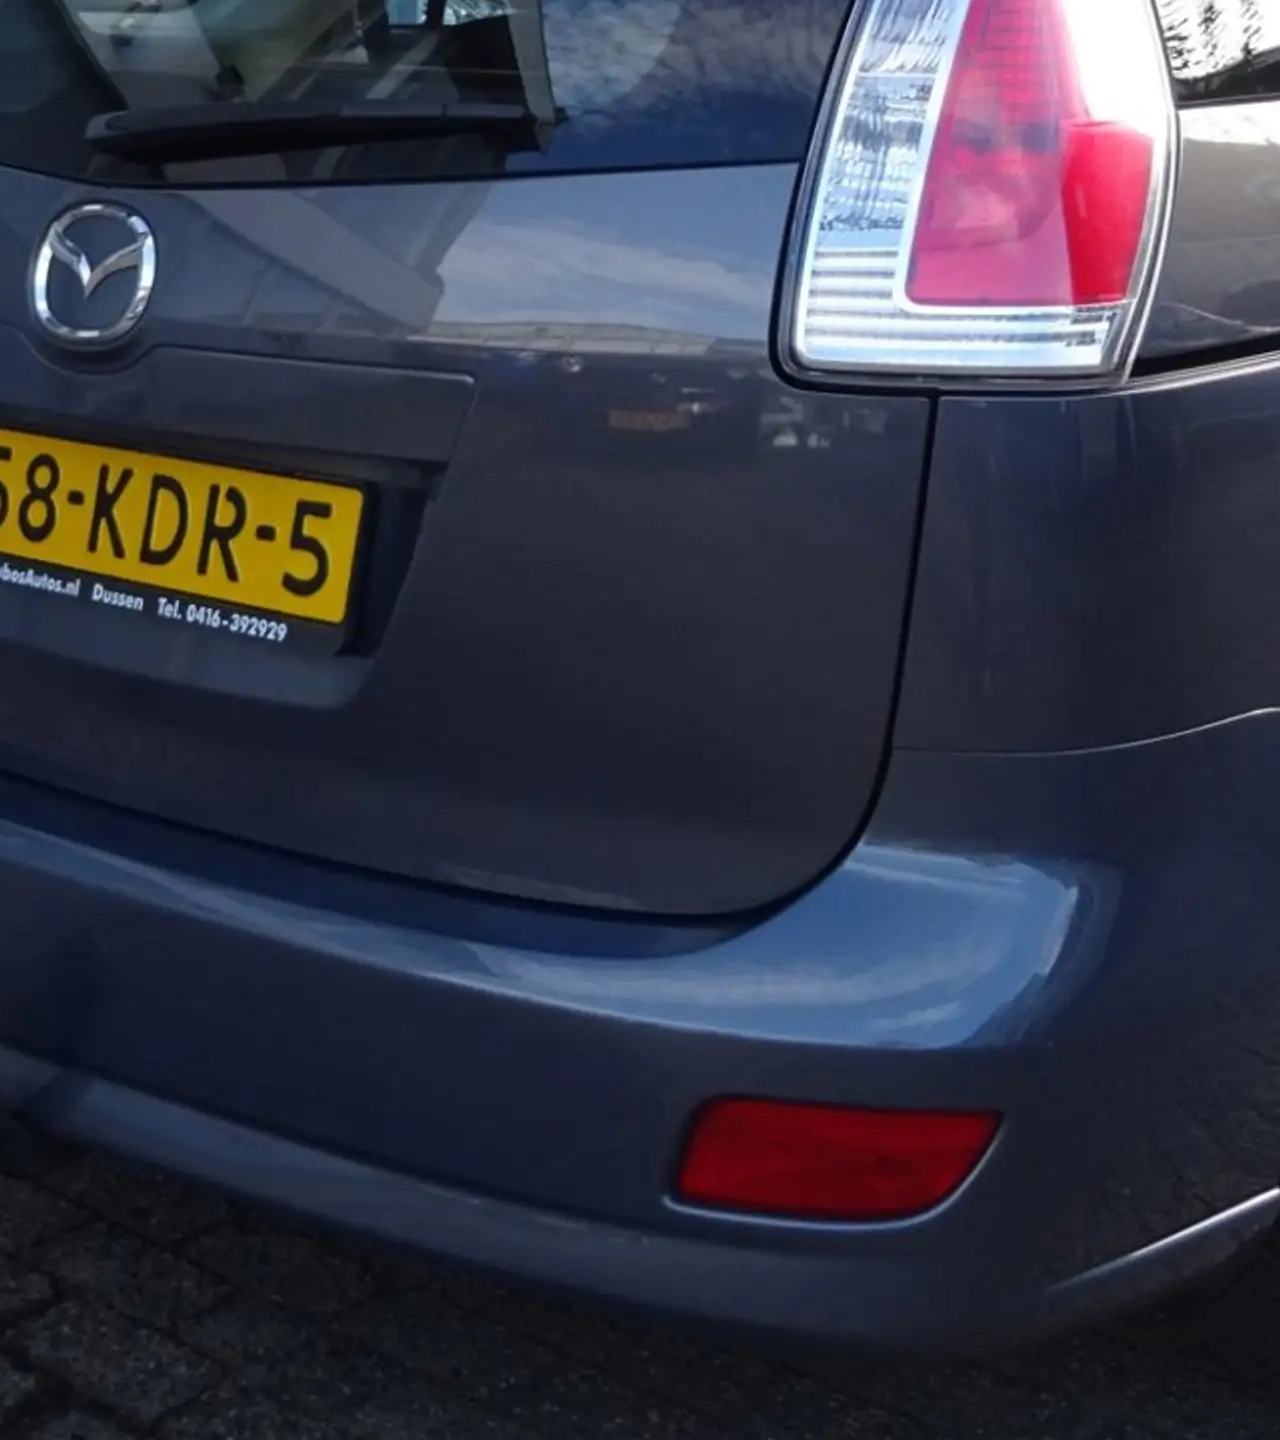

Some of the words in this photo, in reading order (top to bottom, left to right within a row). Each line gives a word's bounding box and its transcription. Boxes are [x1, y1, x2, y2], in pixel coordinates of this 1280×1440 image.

[91, 582, 144, 612] Dussen
[157, 596, 182, 620] Tel.
[186, 603, 289, 642] 0416-392929
